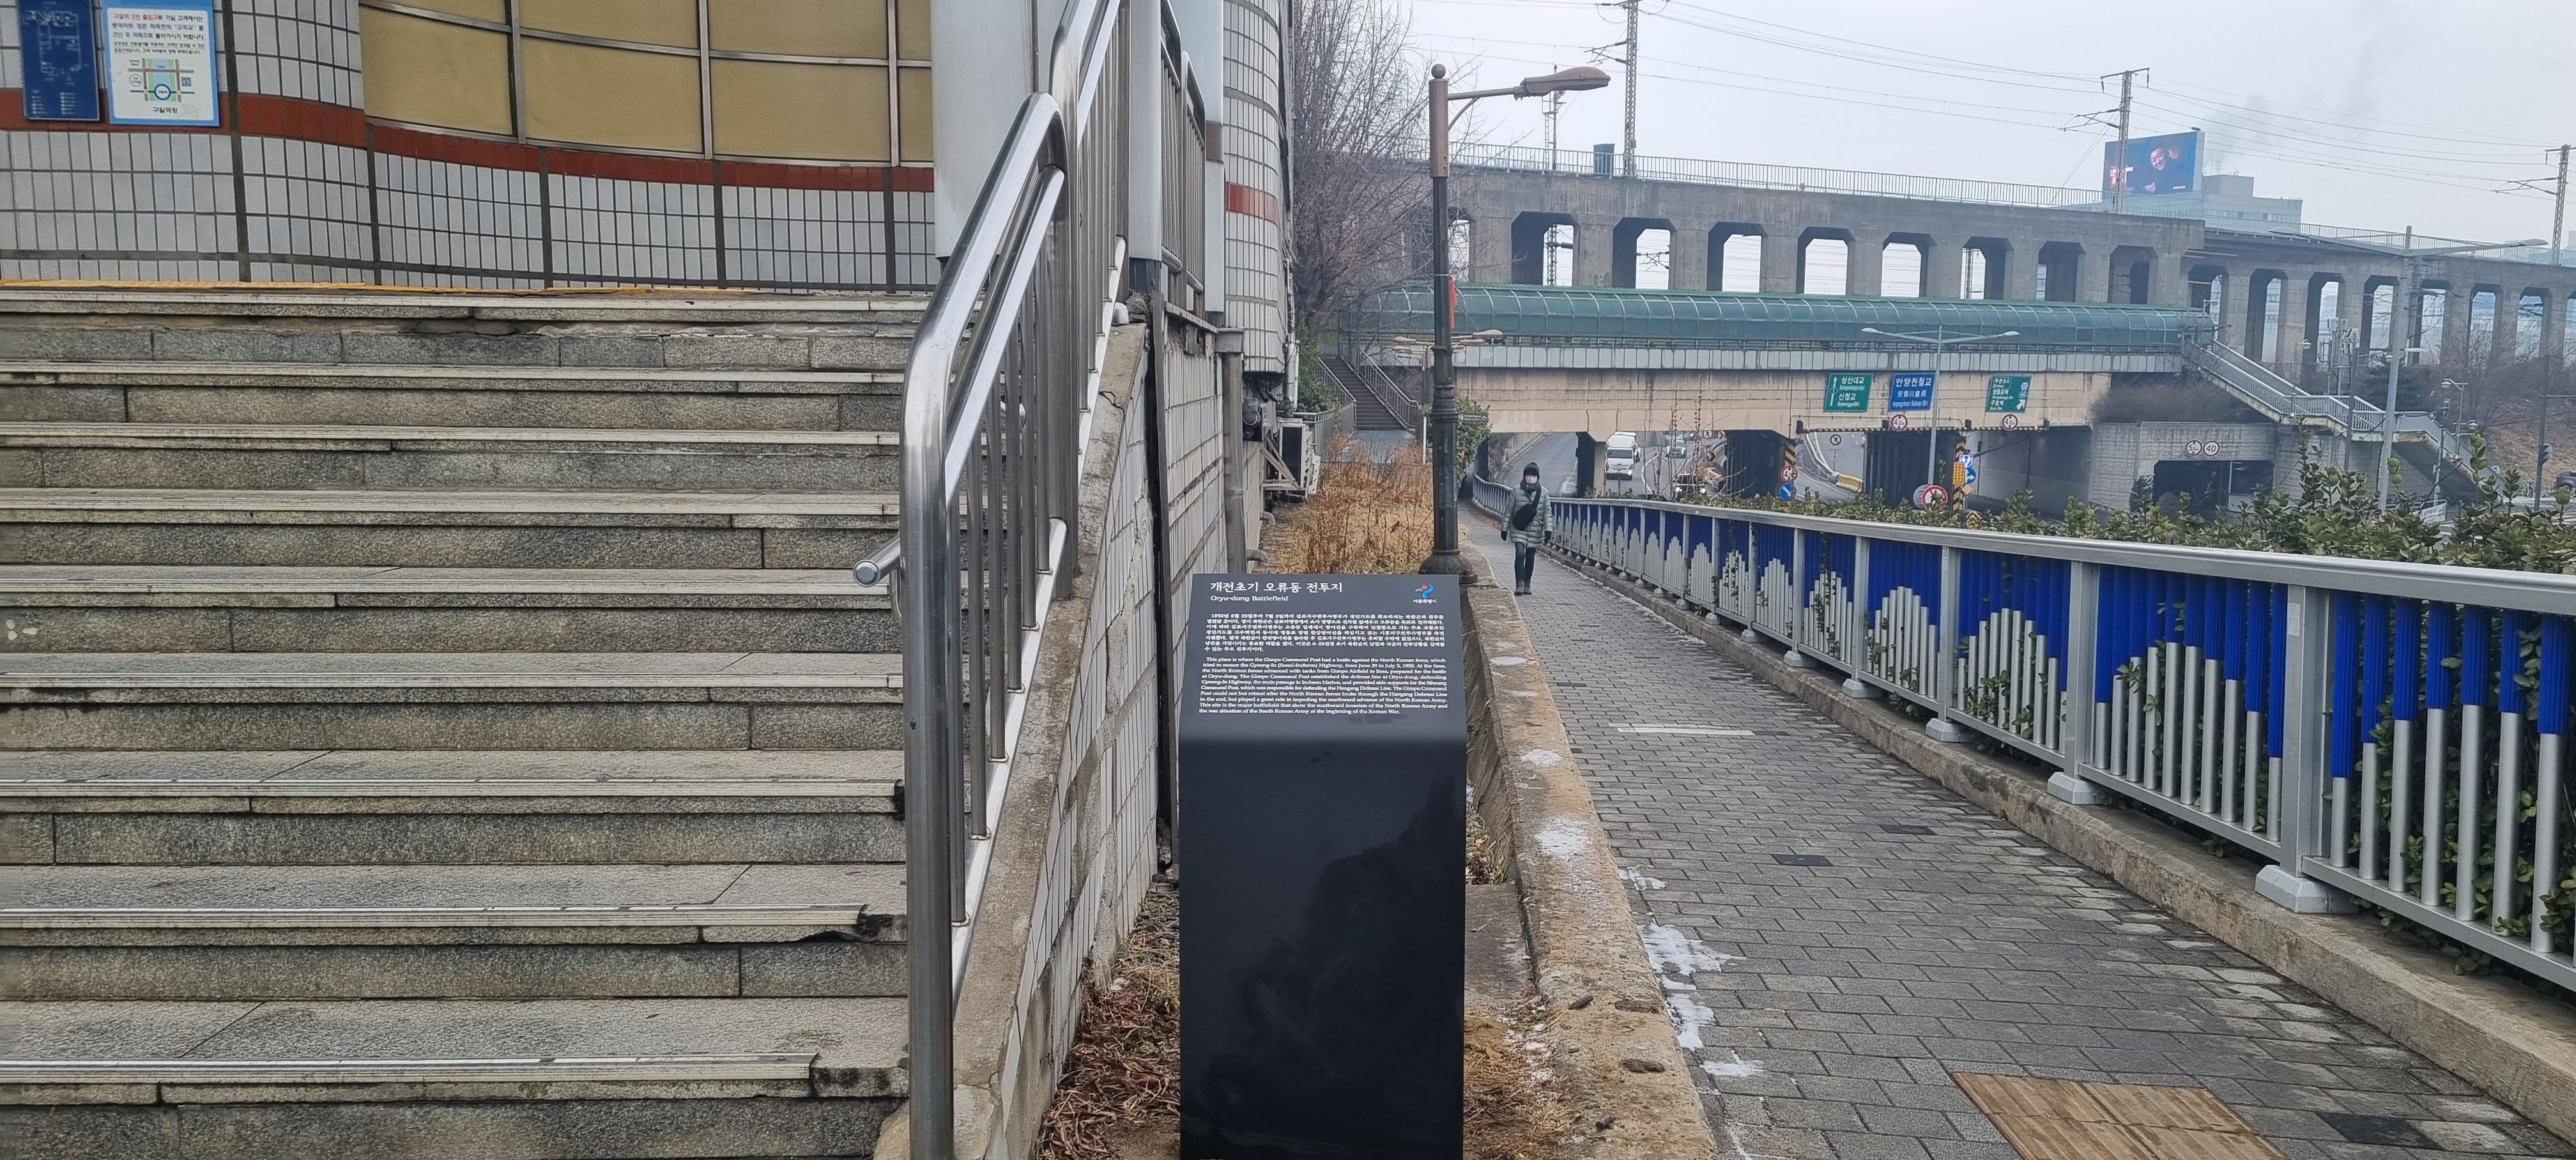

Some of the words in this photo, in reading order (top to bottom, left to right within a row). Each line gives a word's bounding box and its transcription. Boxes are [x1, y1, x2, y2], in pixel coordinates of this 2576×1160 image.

[1841, 376, 1865, 385] 성산대교
[1896, 377, 1932, 387] 안양천철교
[1210, 581, 1259, 593] 개전초기
[1263, 582, 1302, 593] 오류동
[1306, 582, 1342, 593] 전투지
